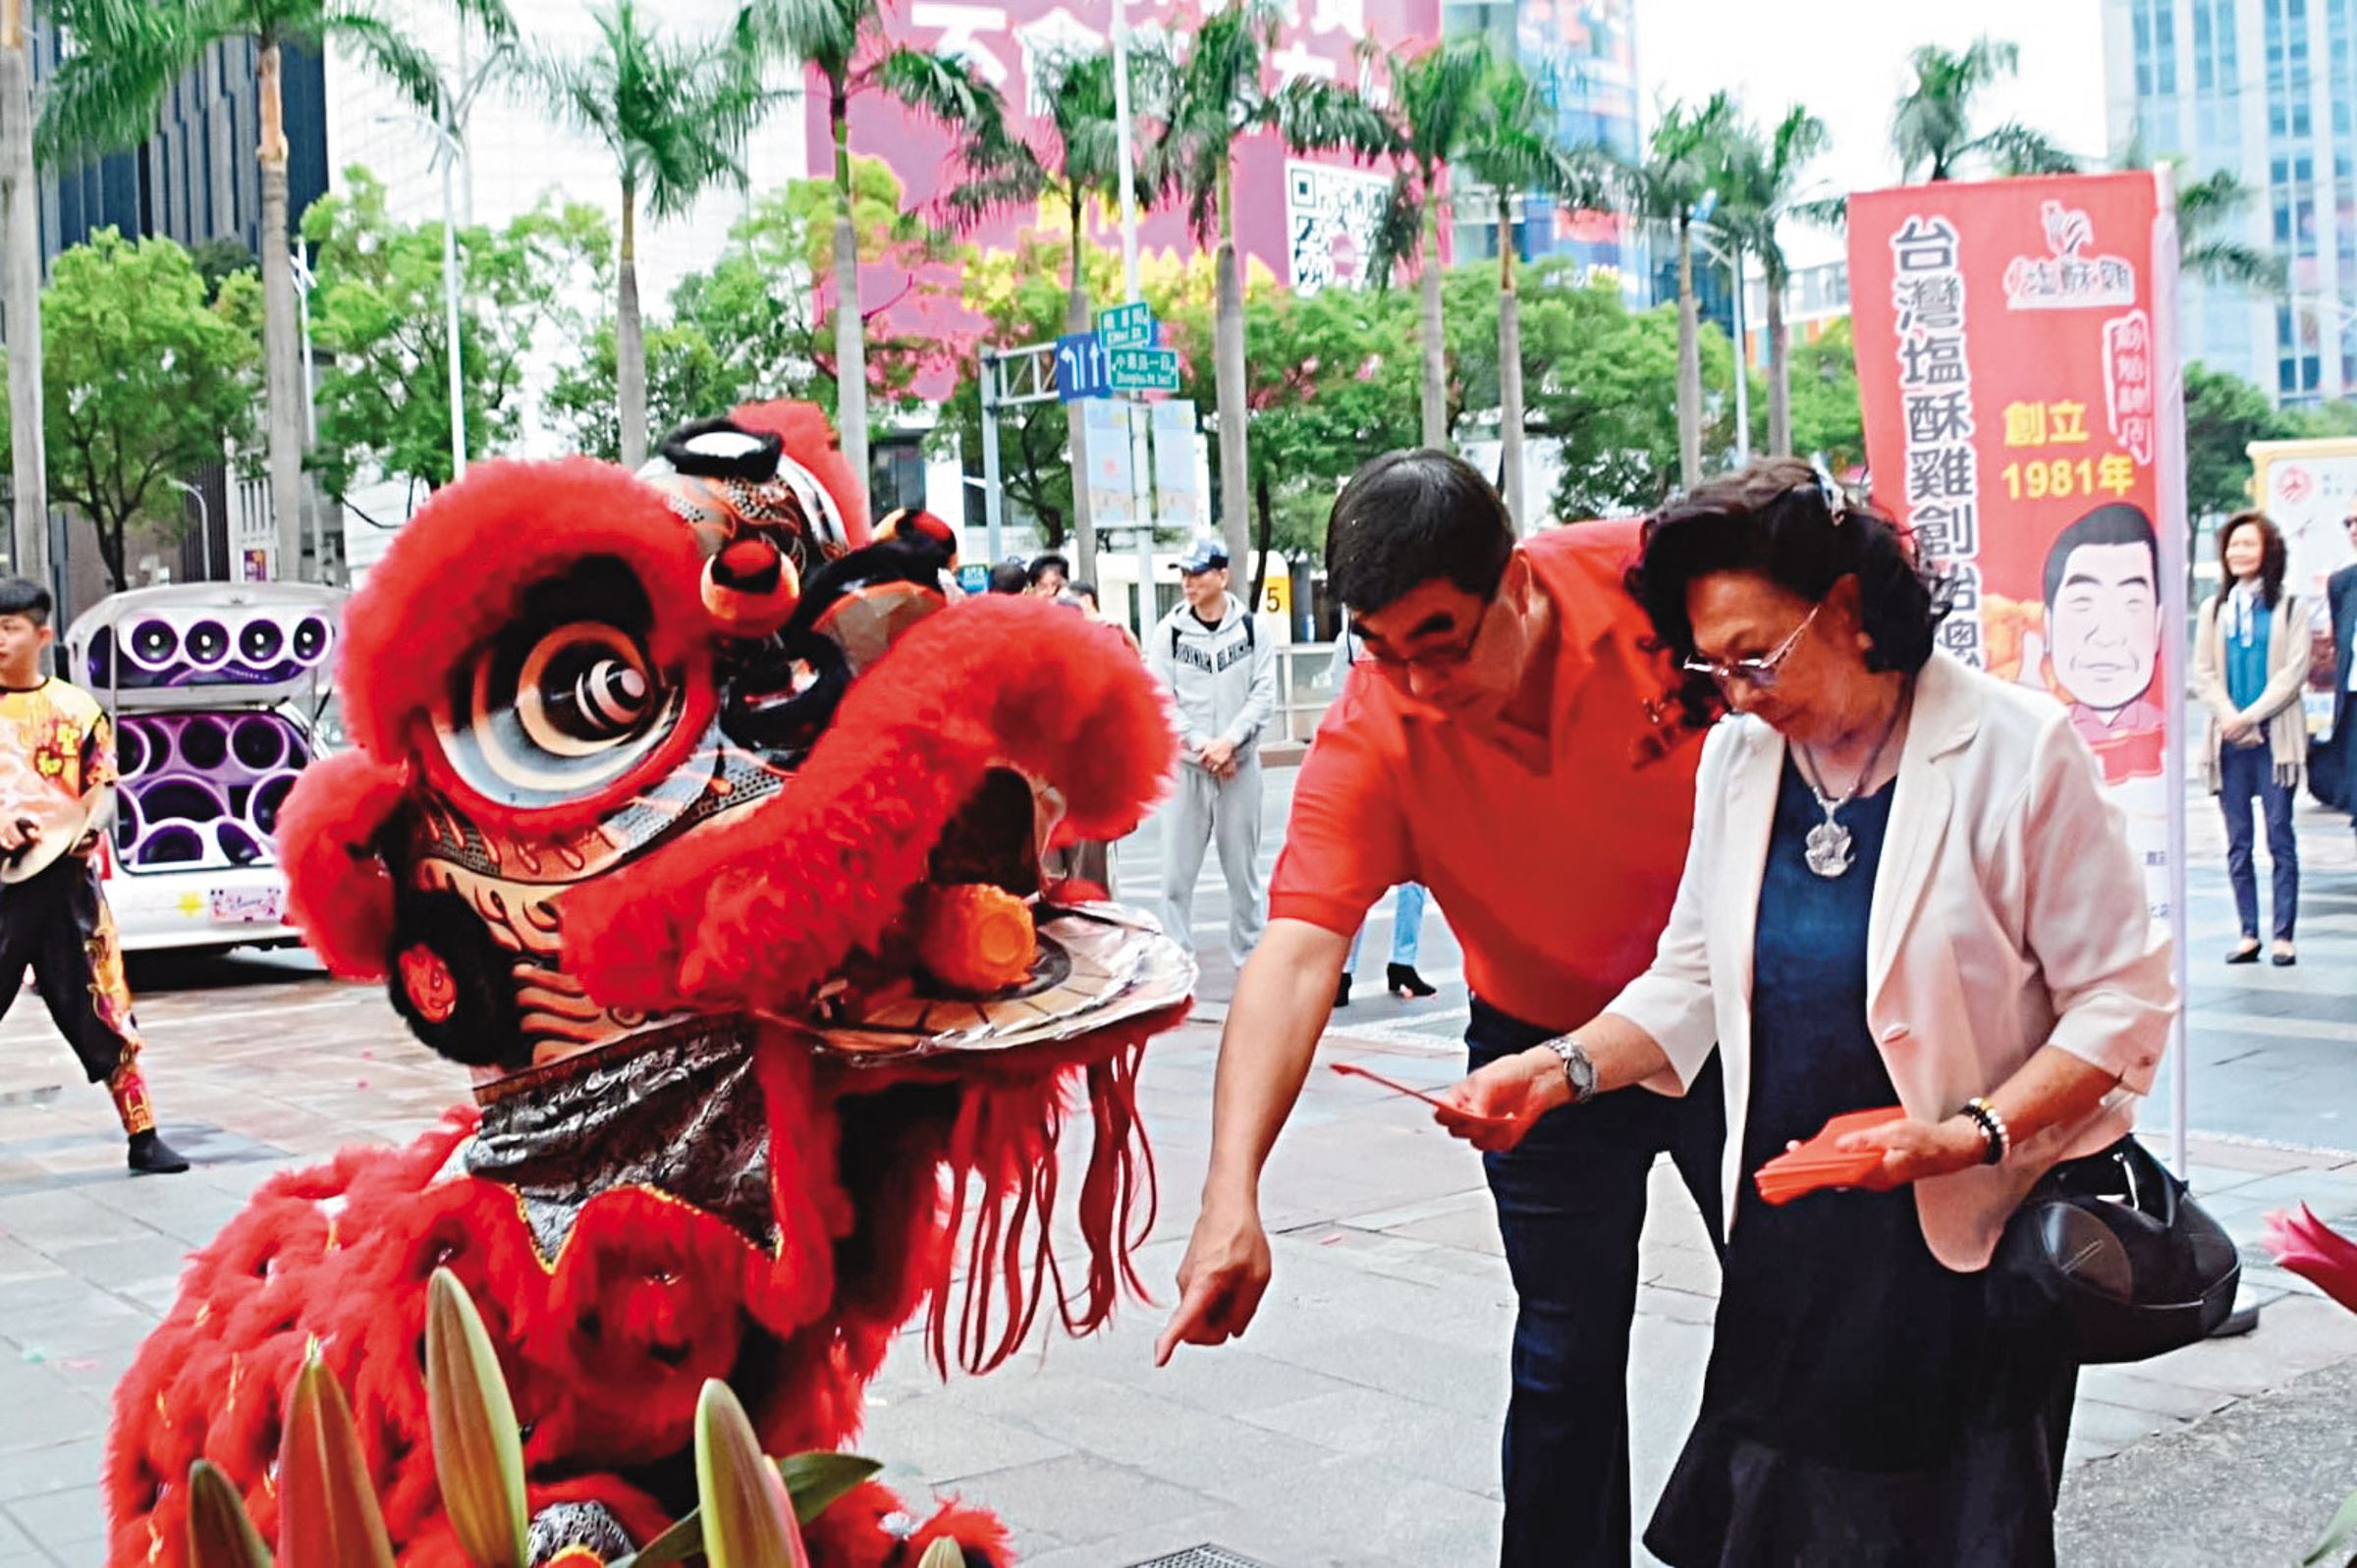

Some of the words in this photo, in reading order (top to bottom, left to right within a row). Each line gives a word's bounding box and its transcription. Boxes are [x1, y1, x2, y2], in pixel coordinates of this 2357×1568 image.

[2003, 400, 2089, 446] 創立
[2001, 452, 2135, 501] 1981年
[1266, 586, 1281, 614] 5
